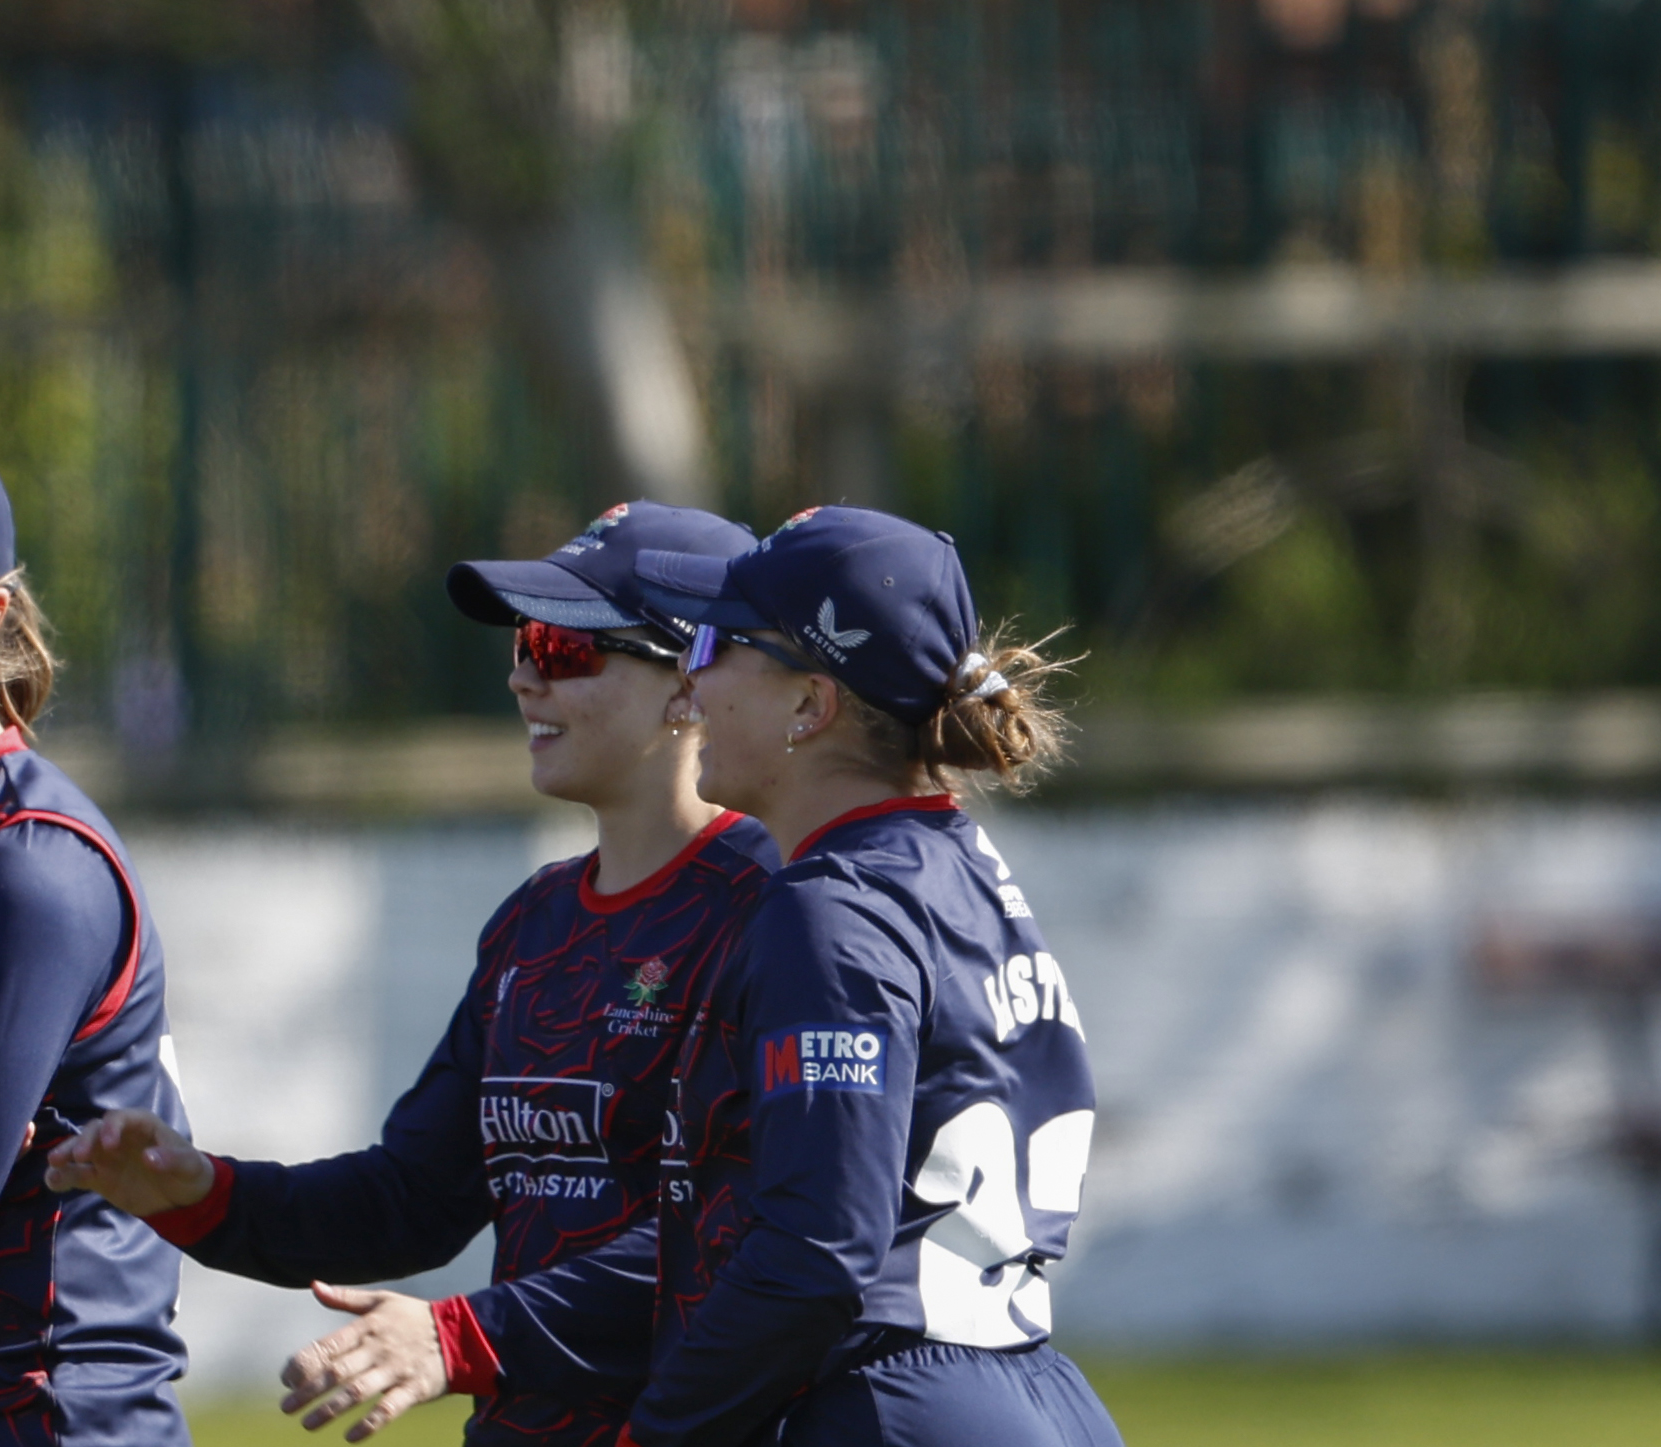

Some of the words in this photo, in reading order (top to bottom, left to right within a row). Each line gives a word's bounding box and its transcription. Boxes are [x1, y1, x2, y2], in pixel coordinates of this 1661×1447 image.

[803, 625, 848, 665] CASTORE
[602, 1002, 675, 1024] Lancashire
[607, 1019, 658, 1037] Cricket
[764, 1031, 880, 1092] METRO
[803, 1062, 878, 1085] BANK
[480, 1096, 592, 1145] Hilton
[544, 1174, 606, 1199] STAY
